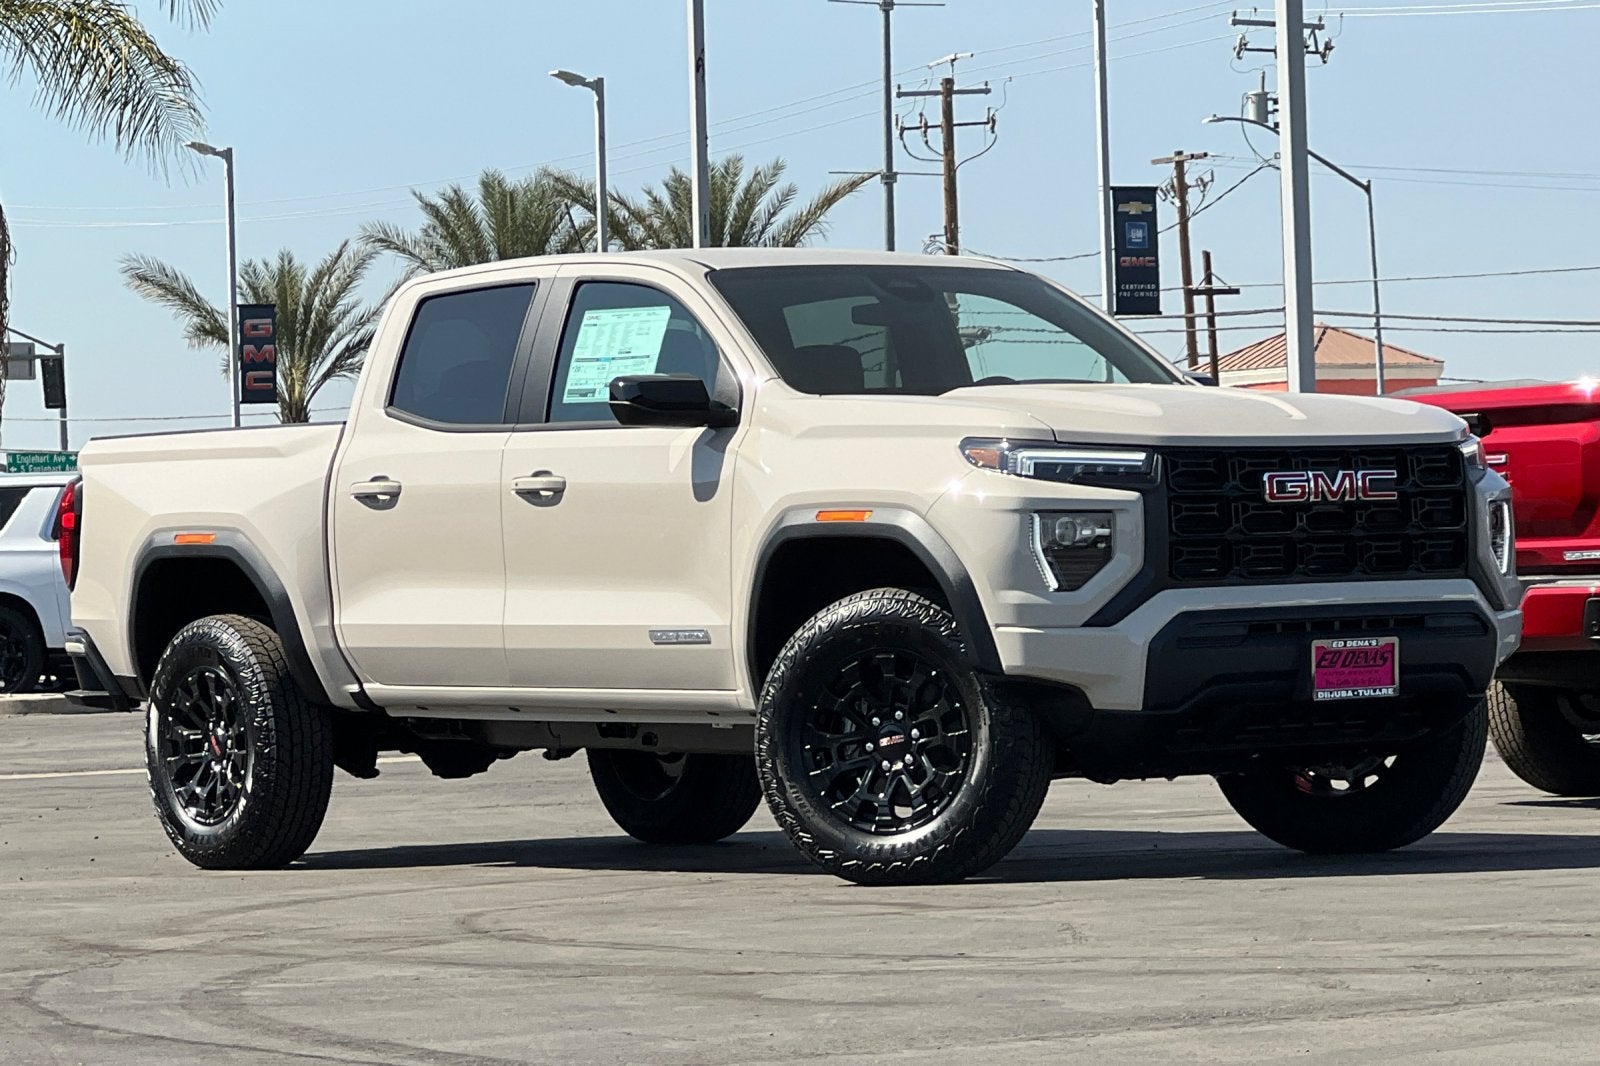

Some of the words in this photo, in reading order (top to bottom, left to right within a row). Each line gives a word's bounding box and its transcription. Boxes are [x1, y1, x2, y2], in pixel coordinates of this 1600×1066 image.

[1120, 256, 1156, 267] GMC
[243, 318, 275, 390] GMC
[8, 455, 13, 463] N
[16, 454, 49, 465] Englehart
[1263, 470, 1398, 502] GMC
[1346, 639, 1377, 647] DENA'S
[1316, 650, 1343, 669] ED
[1358, 688, 1394, 696] TULARE
